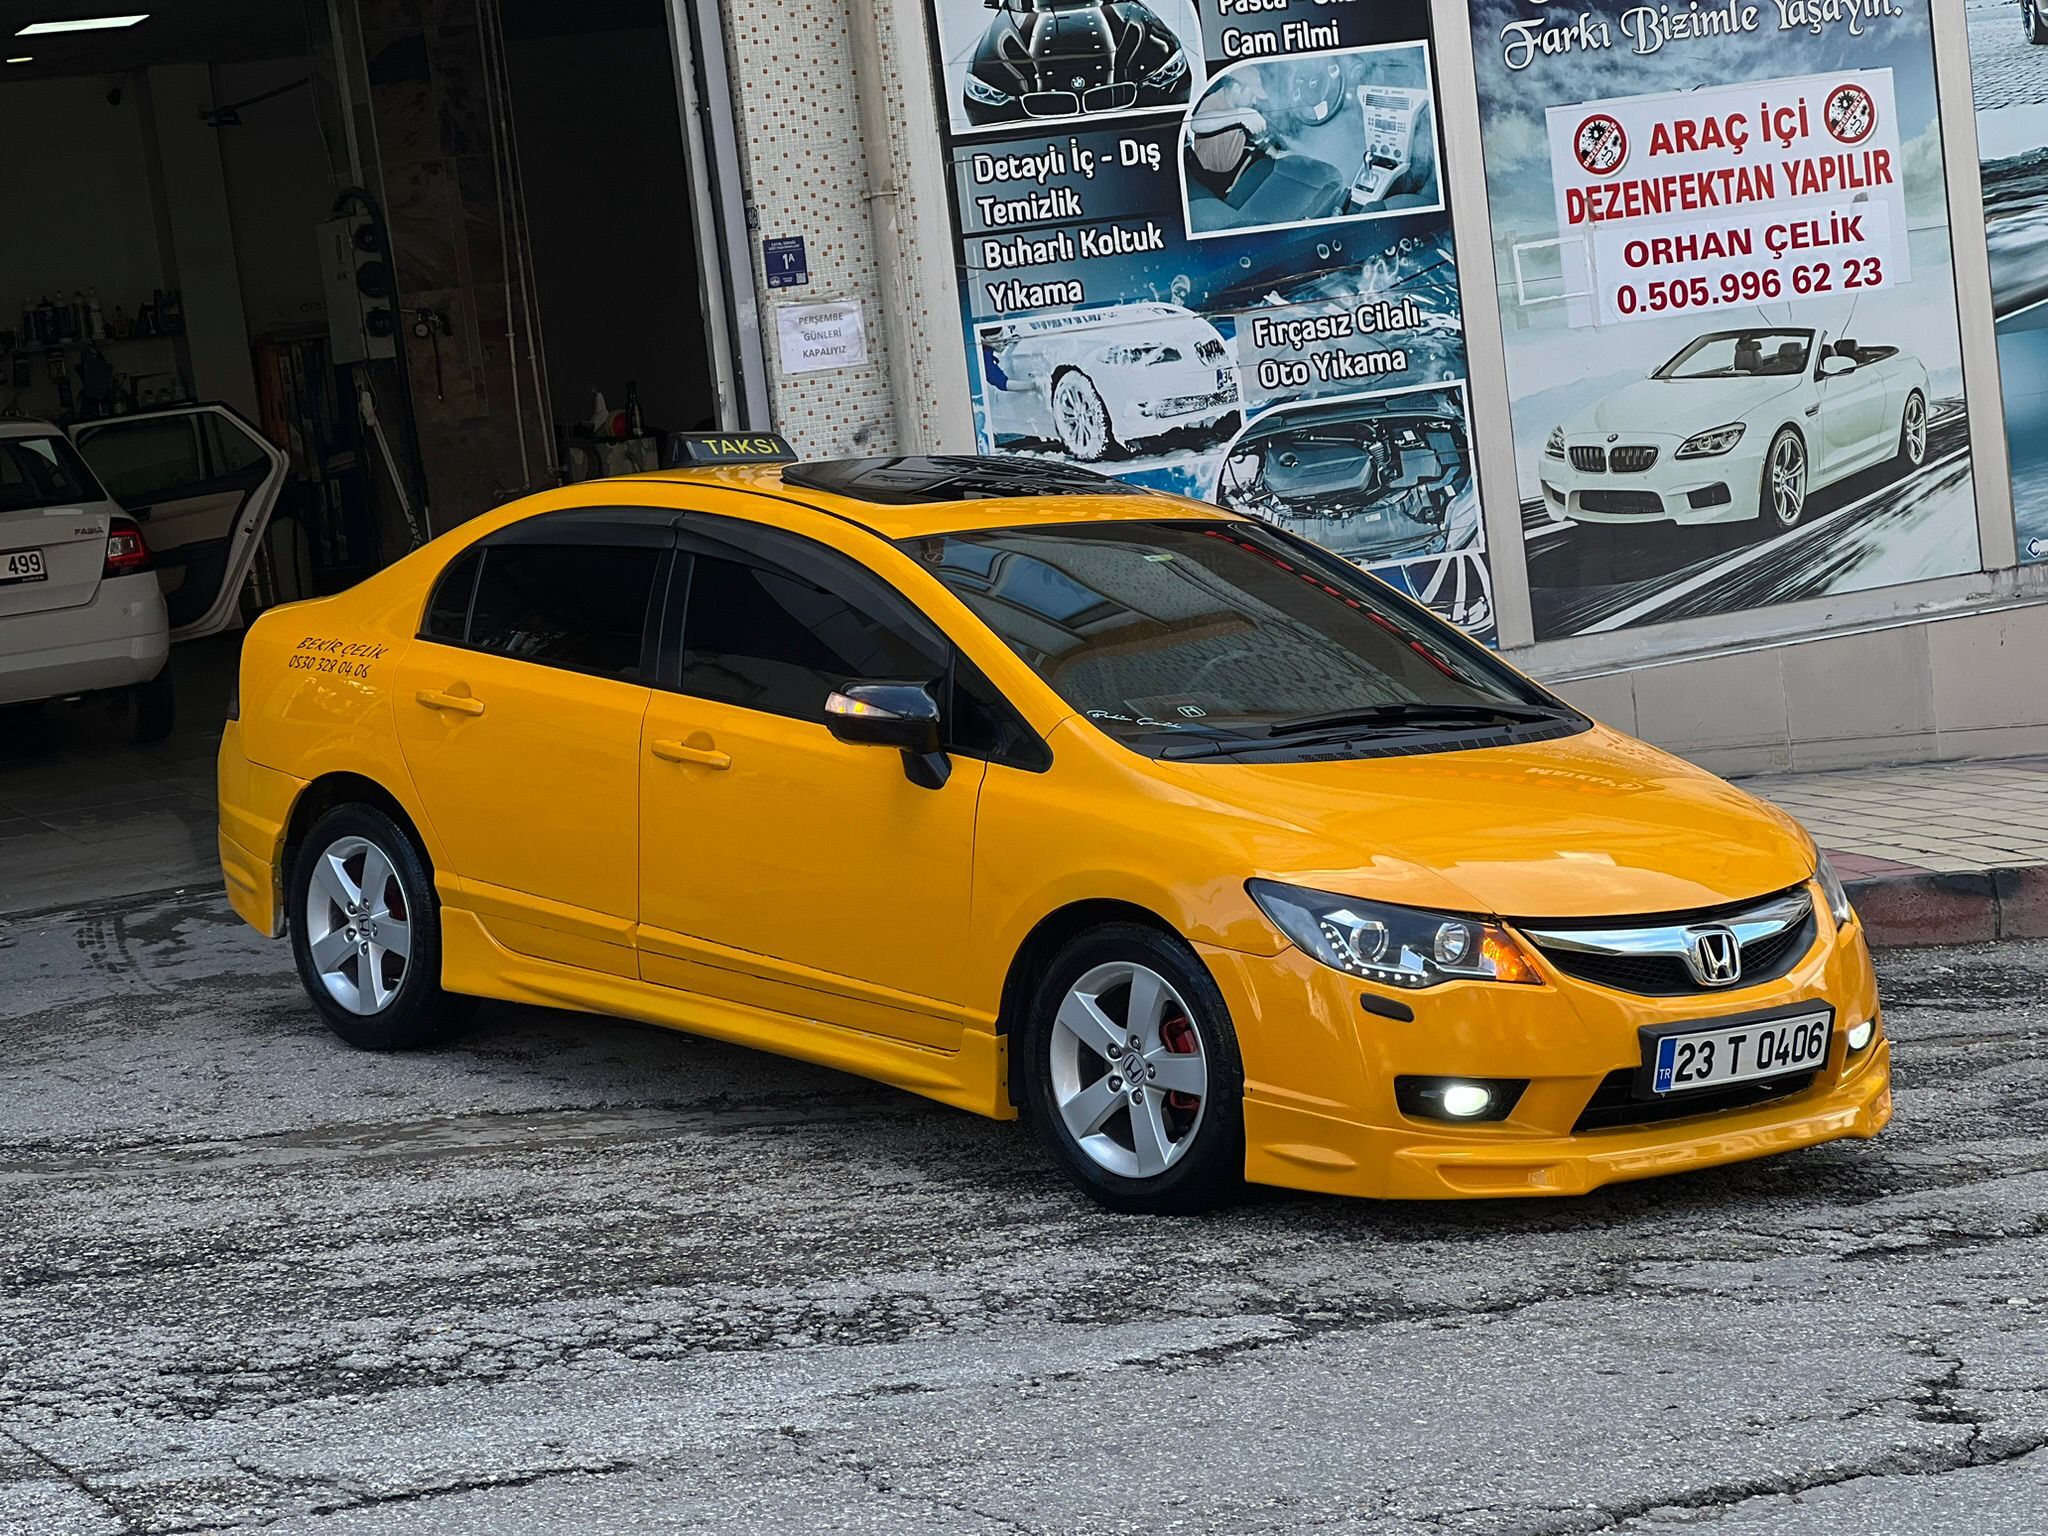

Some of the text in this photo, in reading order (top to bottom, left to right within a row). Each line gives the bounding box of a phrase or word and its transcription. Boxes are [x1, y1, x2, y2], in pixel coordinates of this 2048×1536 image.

[1222, 19, 1341, 57] Cam Filmi
[1500, 12, 1613, 70] Farkı
[1620, 0, 1760, 55] Bizimle
[1648, 97, 1810, 155] ARAÇ İÇİ
[973, 145, 1066, 184] Detaylı
[1070, 138, 1095, 179] İç
[1119, 139, 1162, 172] Dış
[1565, 148, 1894, 225] DEZENFEKTAN YAPILIR
[977, 188, 1083, 226] Temizlik
[983, 222, 1165, 269] Buharlı Koltuk
[1623, 210, 1866, 269] ORHAN ÇELİK
[987, 279, 1084, 313] Yıkama
[1616, 256, 1884, 315] 0.505.996 62 23
[798, 312, 844, 326] PERŞEMBE
[803, 327, 842, 342] GÜNLERİ
[1254, 298, 1421, 350] Fırçasız Cilalı
[802, 345, 847, 359] KAPALIYIZ
[1259, 350, 1408, 388] Oto Yıkama
[8, 553, 42, 575] 499
[288, 654, 372, 679] 0530 328 04 06
[297, 637, 389, 660] BEKİR ÇELİK
[1674, 1021, 1825, 1083] 23 T 0406
[1659, 1068, 1671, 1080] TR
